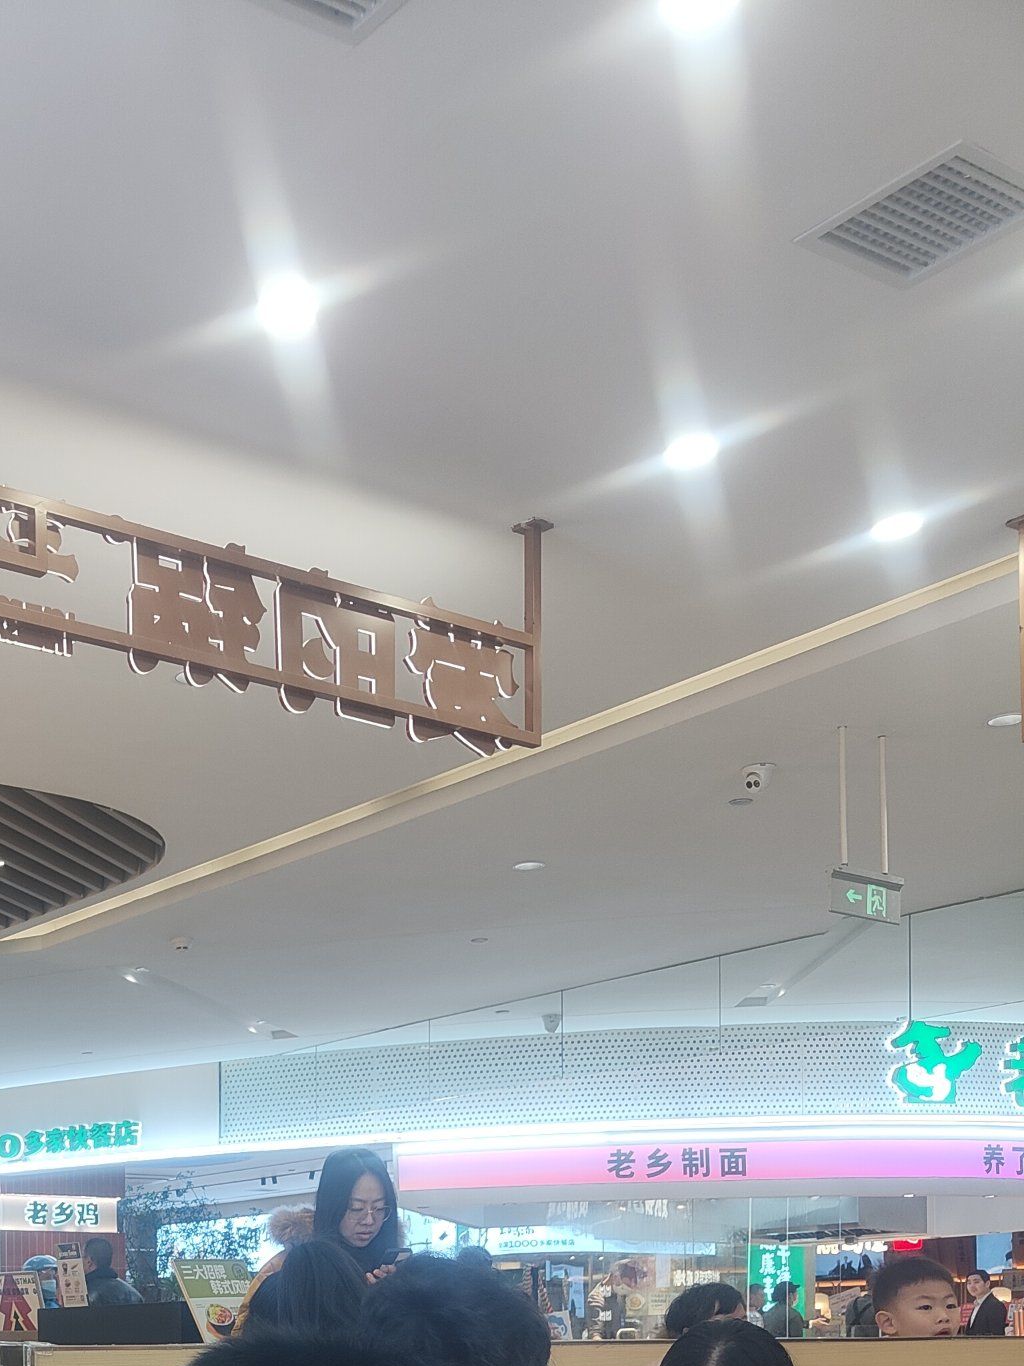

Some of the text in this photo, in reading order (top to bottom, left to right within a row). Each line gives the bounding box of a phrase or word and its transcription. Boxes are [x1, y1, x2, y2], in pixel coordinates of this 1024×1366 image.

[607, 1147, 748, 1179] 老乡制面
[25, 1200, 99, 1226] 老乡鸡
[180, 1264, 227, 1280] 三大招牌
[209, 1279, 251, 1295] 韩式风味
